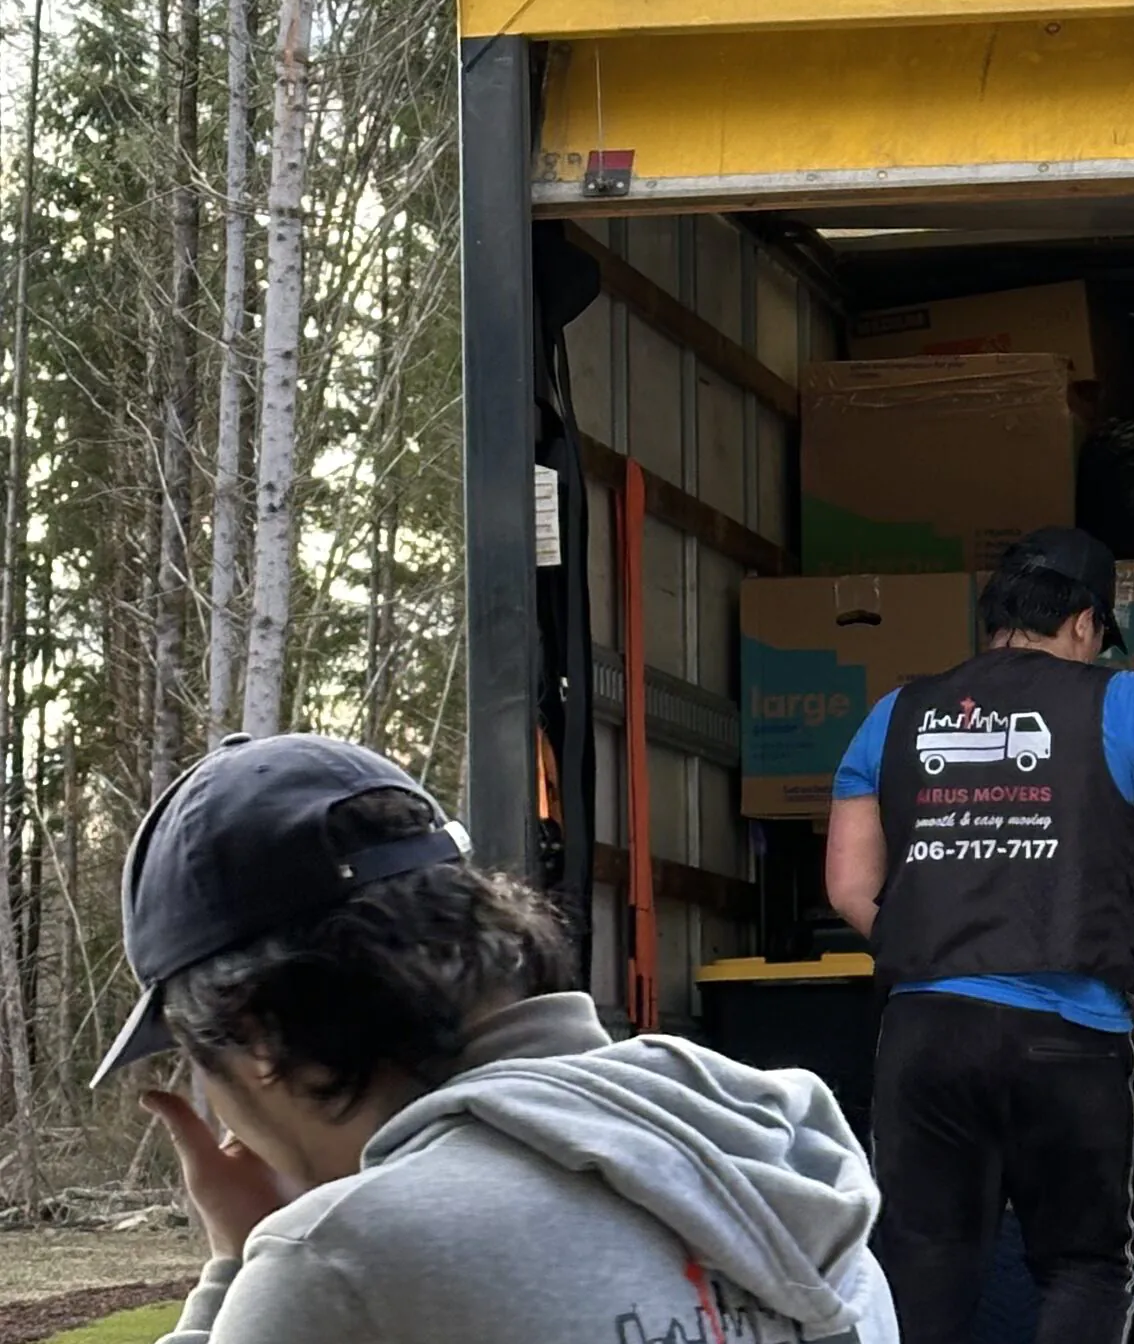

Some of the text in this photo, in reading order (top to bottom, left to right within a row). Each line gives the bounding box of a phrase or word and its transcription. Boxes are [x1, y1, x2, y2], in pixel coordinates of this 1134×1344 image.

[750, 684, 850, 727] large
[916, 786, 1053, 804] AIRUS MOVERS
[959, 810, 971, 826] &
[974, 814, 1004, 831] easy
[1007, 813, 1053, 830] moving
